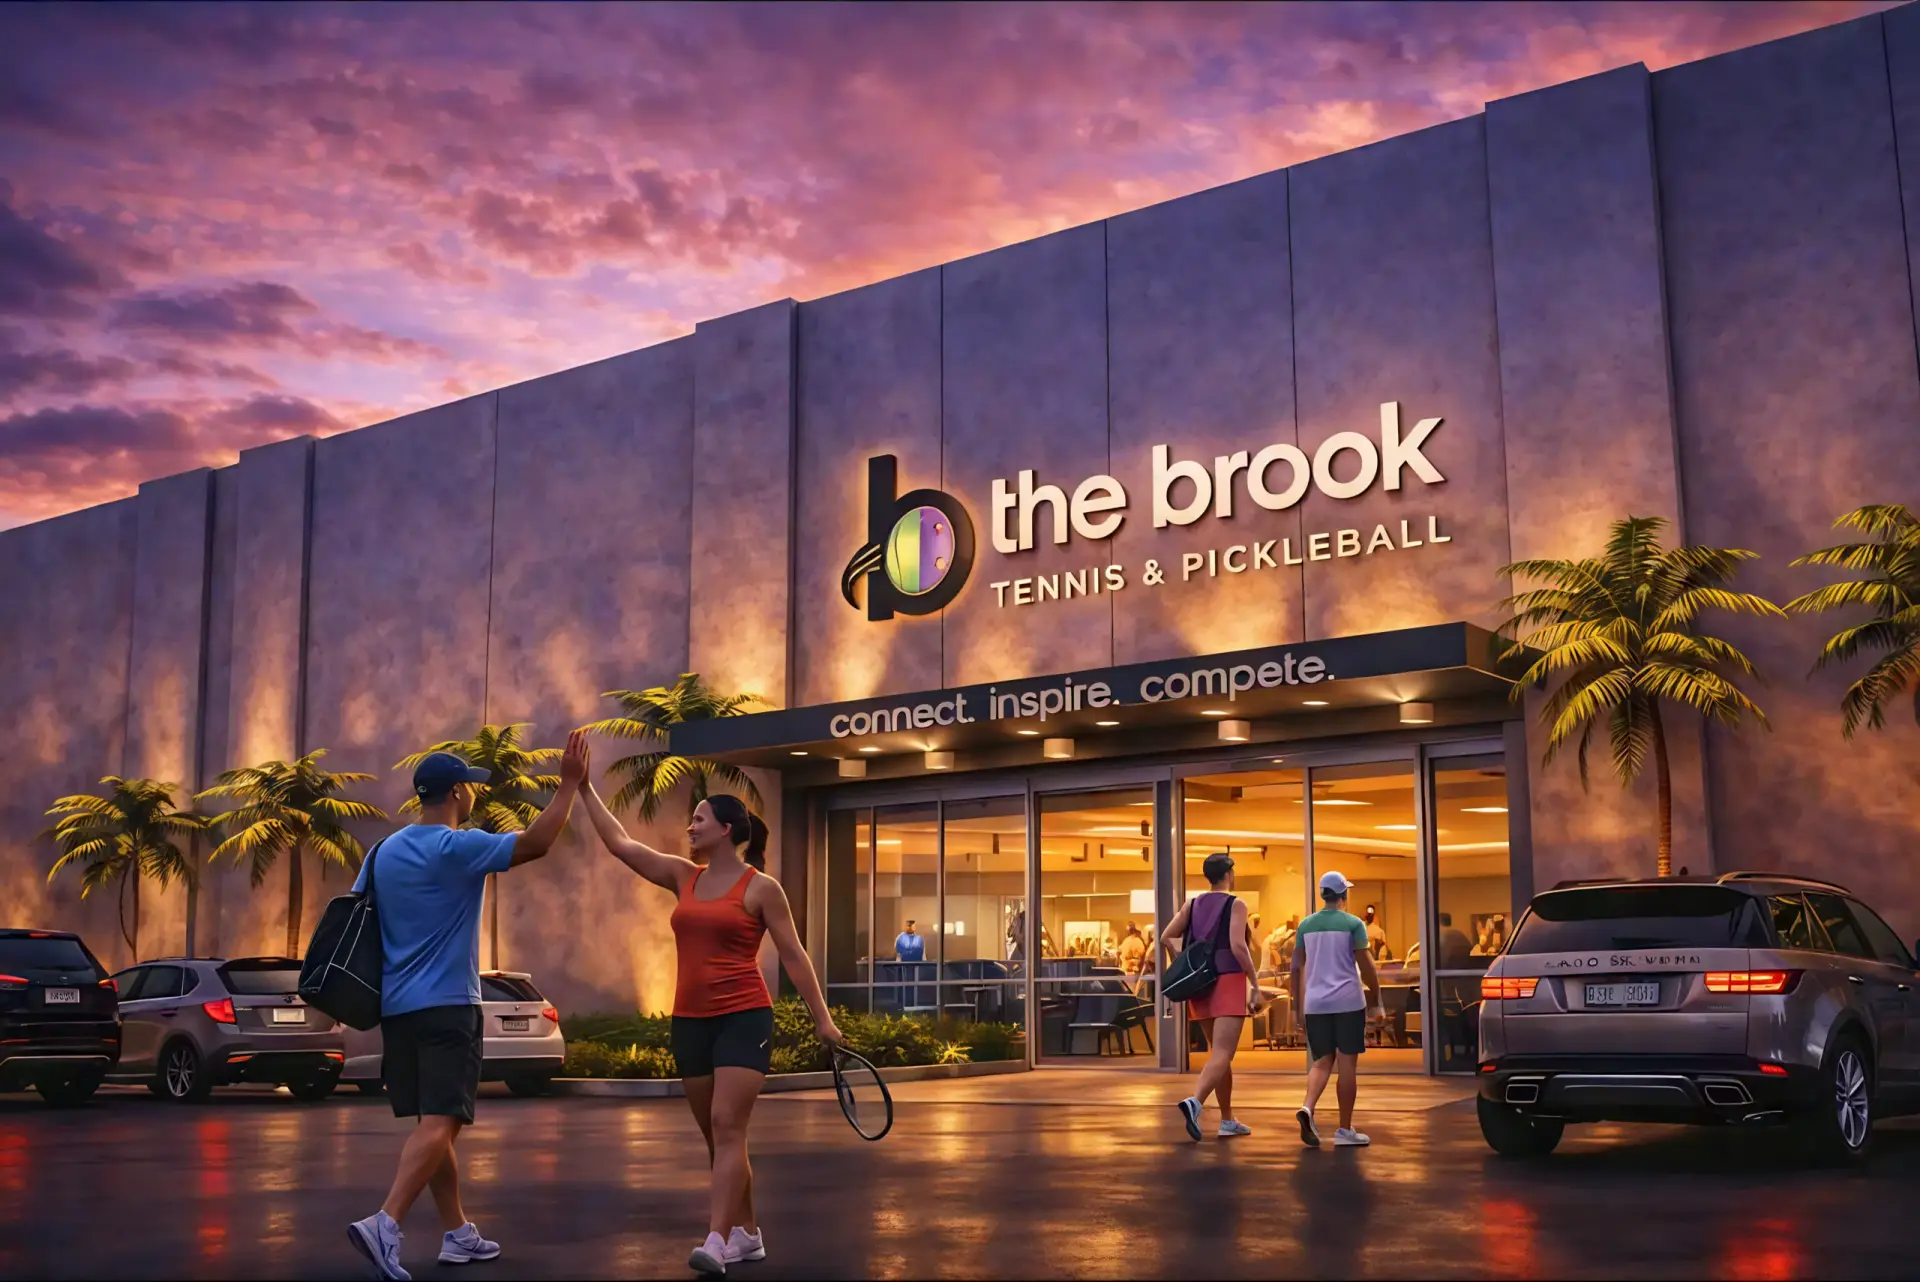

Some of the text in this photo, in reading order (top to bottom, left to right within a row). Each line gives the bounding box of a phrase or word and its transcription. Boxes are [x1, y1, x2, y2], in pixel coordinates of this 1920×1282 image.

[991, 401, 1446, 554] the brook
[990, 515, 1452, 608] TENNIS & PICKLEBALL
[829, 652, 1336, 739] connect. inspire. compete.
